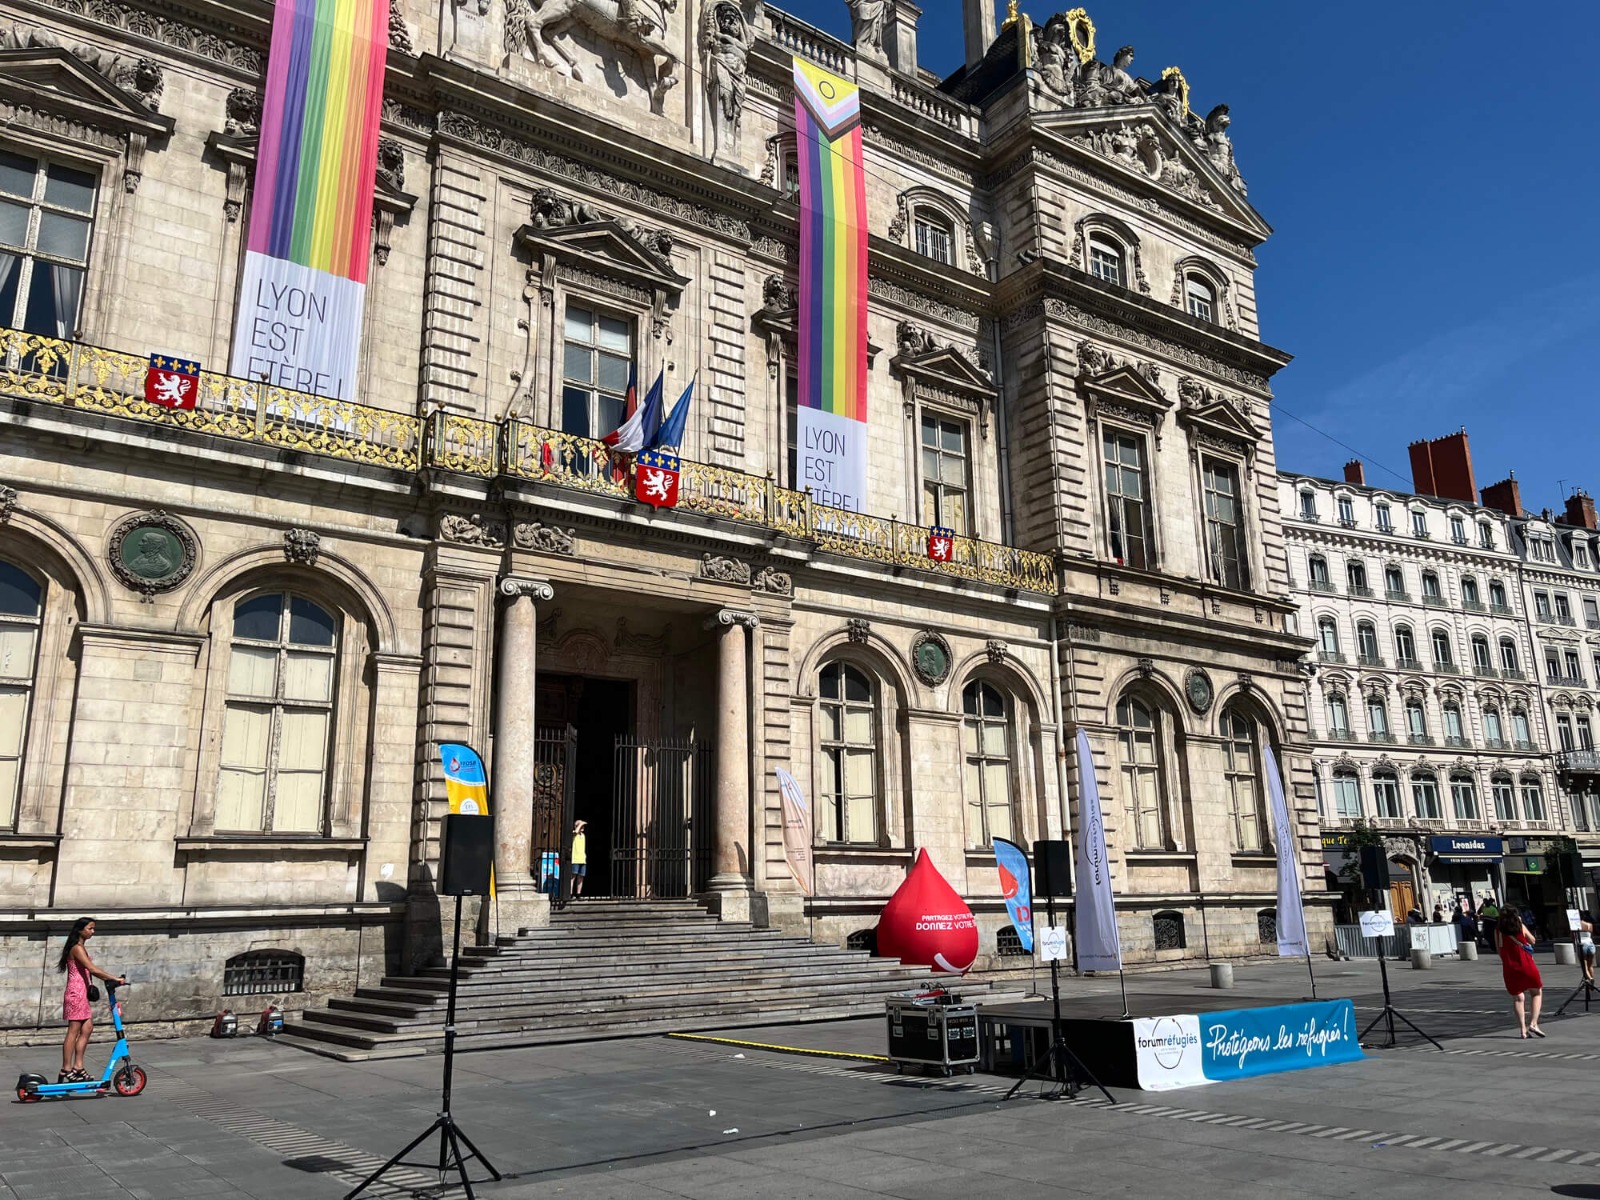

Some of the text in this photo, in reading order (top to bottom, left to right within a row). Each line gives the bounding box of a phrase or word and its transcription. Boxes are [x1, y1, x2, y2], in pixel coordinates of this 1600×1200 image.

[257, 279, 327, 323] LYON
[252, 317, 305, 355] EST
[805, 426, 845, 456] LYON
[805, 456, 834, 482] EST
[1451, 839, 1486, 850] Leonidas
[915, 921, 953, 931] DONNEZ
[1137, 1032, 1198, 1049] forumréfugiés
[1206, 1024, 1271, 1070] Protégeons
[1272, 1024, 1293, 1050] les
[1296, 1016, 1341, 1057] réfugiés
